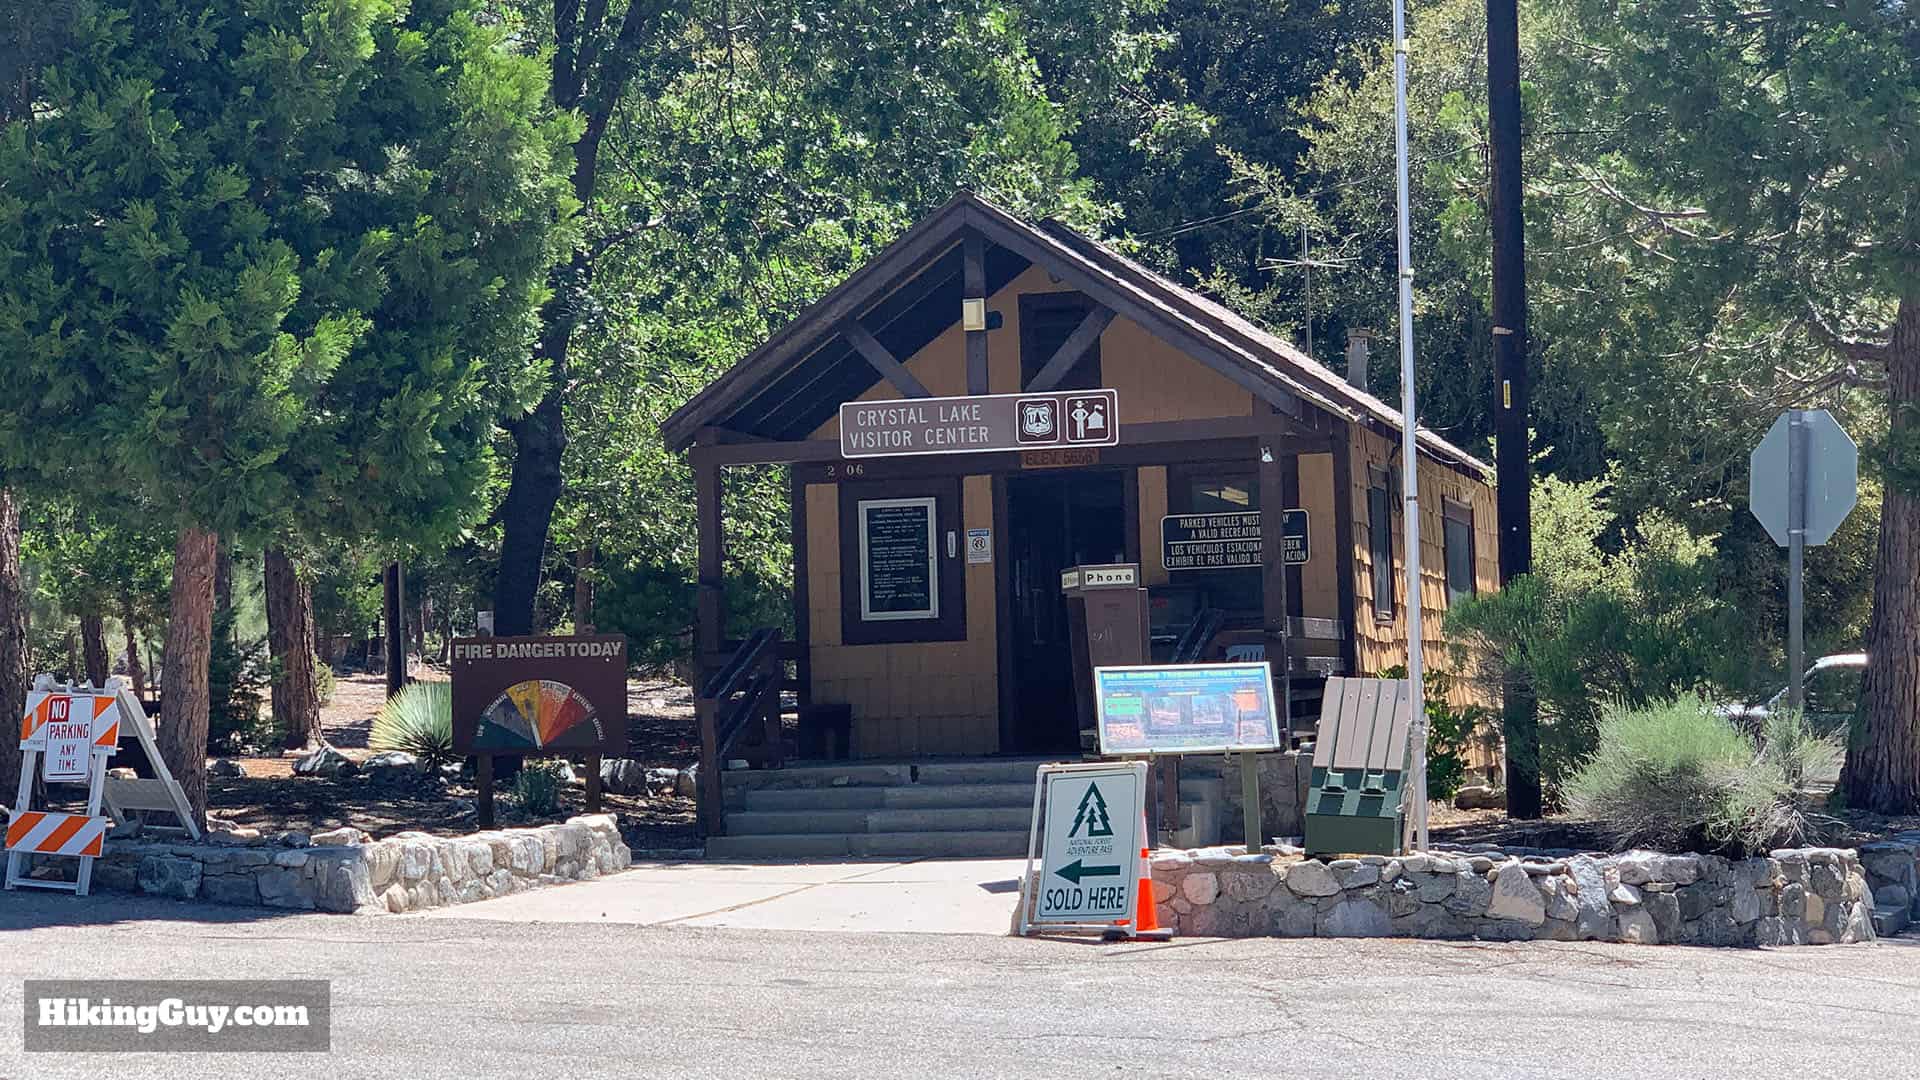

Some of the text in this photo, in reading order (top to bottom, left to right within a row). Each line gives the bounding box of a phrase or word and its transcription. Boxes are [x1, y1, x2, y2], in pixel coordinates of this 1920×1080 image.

[857, 405, 981, 426] CRYSTAL LAKE
[849, 427, 989, 449] VISITOR CENTER
[827, 464, 865, 476] 2 06
[1180, 515, 1260, 529] PARKED VEHICLES MUST
[1191, 527, 1262, 540] A VALID RECREATION
[1171, 545, 1185, 556] LOS
[1187, 543, 1224, 555] VEHICULOS
[1166, 556, 1194, 567] EXHIBIR
[1197, 555, 1205, 566] EL
[1207, 554, 1225, 565] PASE
[1226, 553, 1250, 564] VALIDO
[1253, 552, 1262, 563] DE
[1087, 573, 1132, 583] Phone
[455, 641, 622, 659] FIRE DANGER TODAY
[51, 700, 67, 719] NO
[49, 723, 89, 740] PARKING
[60, 743, 77, 756] ANY
[57, 758, 77, 771] TIME
[1066, 847, 1099, 856] ADVENTURE
[1045, 887, 1125, 911] SOLD HERE
